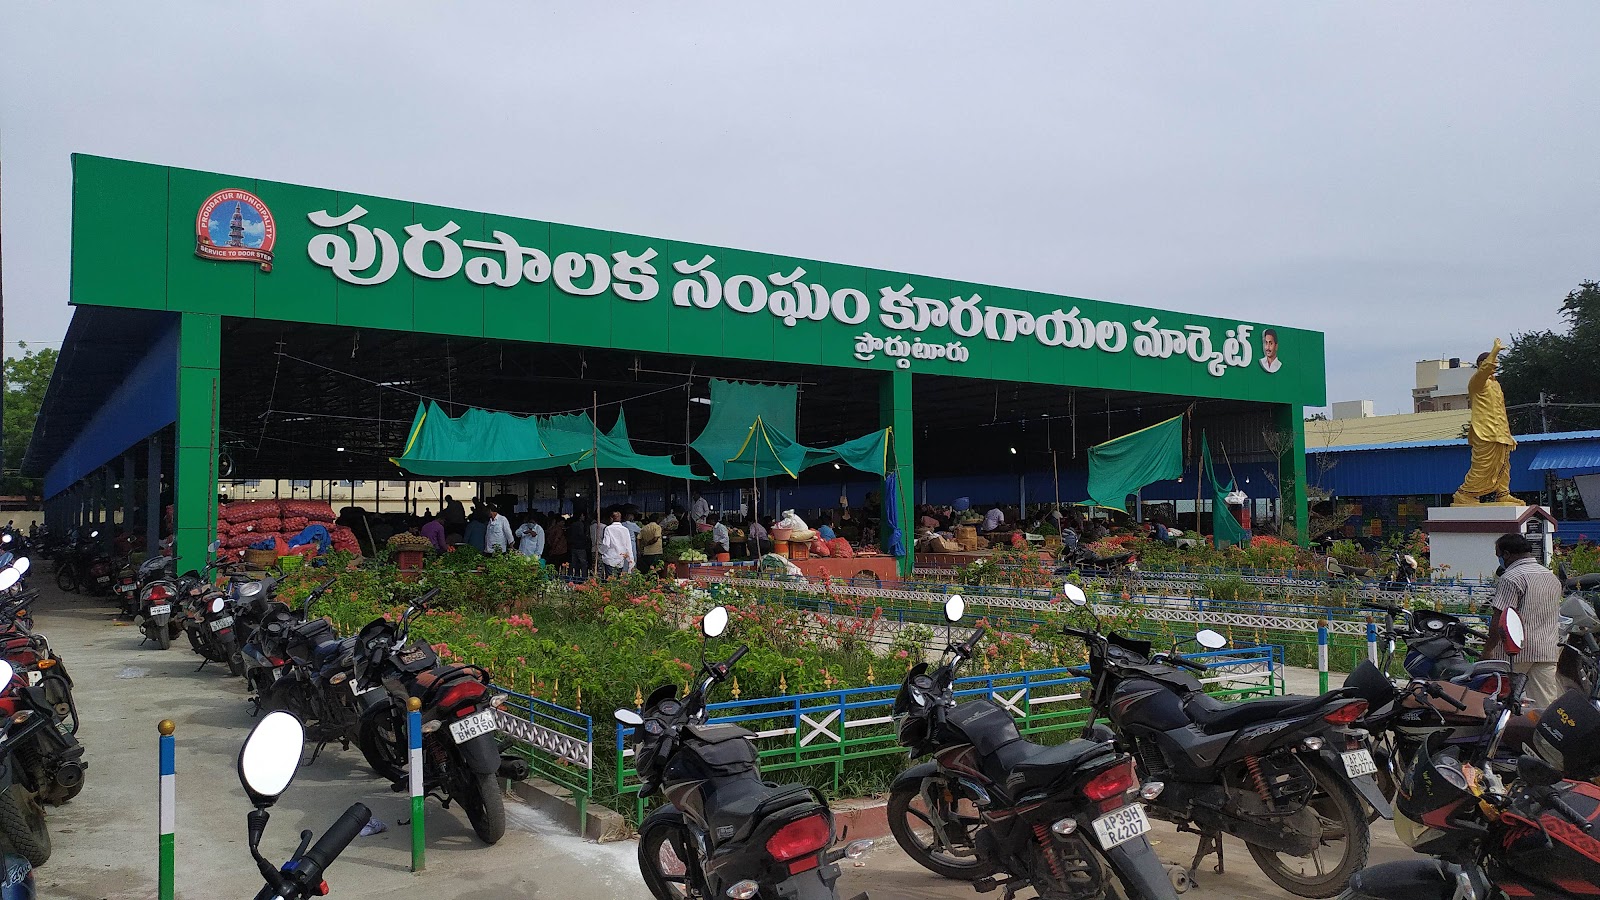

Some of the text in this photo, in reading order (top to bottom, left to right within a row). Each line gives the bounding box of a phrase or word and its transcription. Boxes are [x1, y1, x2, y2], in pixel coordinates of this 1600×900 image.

[201, 193, 272, 239] PRODDATUR MUNICIPALITY
[201, 246, 227, 257] SERVICE
[256, 252, 272, 261] STEP
[307, 204, 1254, 377] పురపాలక సంఘం కూరగాయల మార్కెట్
[457, 720, 495, 740] BM8150
[458, 720, 470, 731] AP
[1348, 753, 1357, 765] AP
[1108, 819, 1143, 844] R4207
